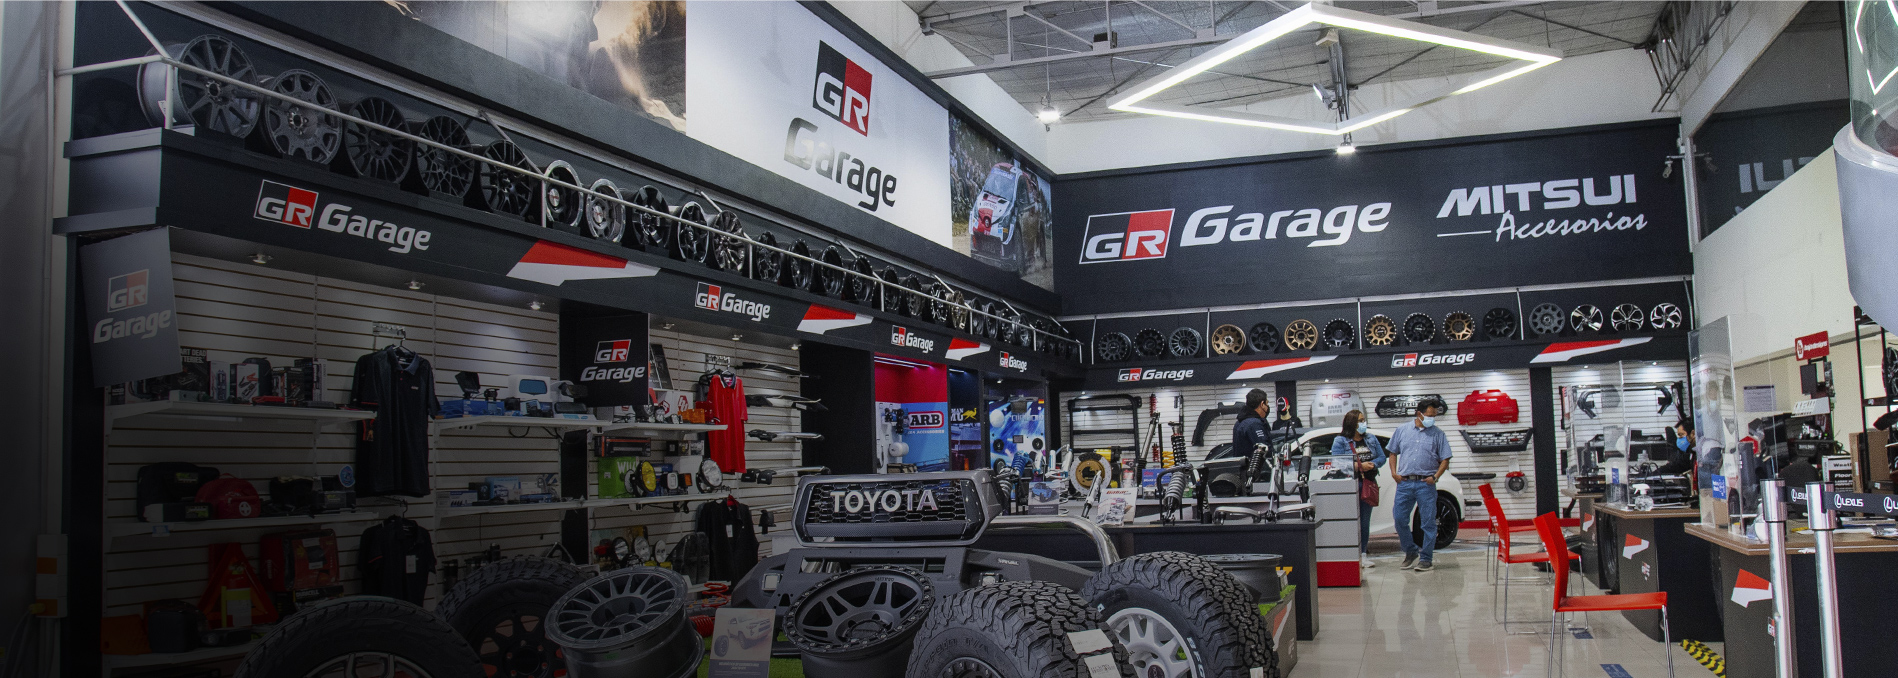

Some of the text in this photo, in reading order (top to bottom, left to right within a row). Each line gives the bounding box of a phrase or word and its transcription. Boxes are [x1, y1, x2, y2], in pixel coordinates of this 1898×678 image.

[815, 71, 869, 133] GR
[784, 117, 897, 212] Garage
[1436, 174, 1636, 218] MITSUI
[257, 196, 431, 254] GR Garage
[1085, 202, 1391, 259] GR Garage
[1496, 210, 1647, 241] Accesorios
[110, 285, 146, 310] GR
[697, 294, 771, 321] GR Garage
[93, 310, 171, 343] Garage
[597, 348, 629, 361] GR
[906, 332, 934, 354] Garage
[1009, 356, 1027, 372] Garage
[1419, 352, 1476, 366] Garage
[581, 365, 645, 383] Garage
[1143, 368, 1194, 380] Garage
[1322, 392, 1351, 401] TRD
[910, 414, 940, 426] ARB
[830, 490, 939, 513] TOYOTA
[1841, 498, 1864, 506] LEXUS
